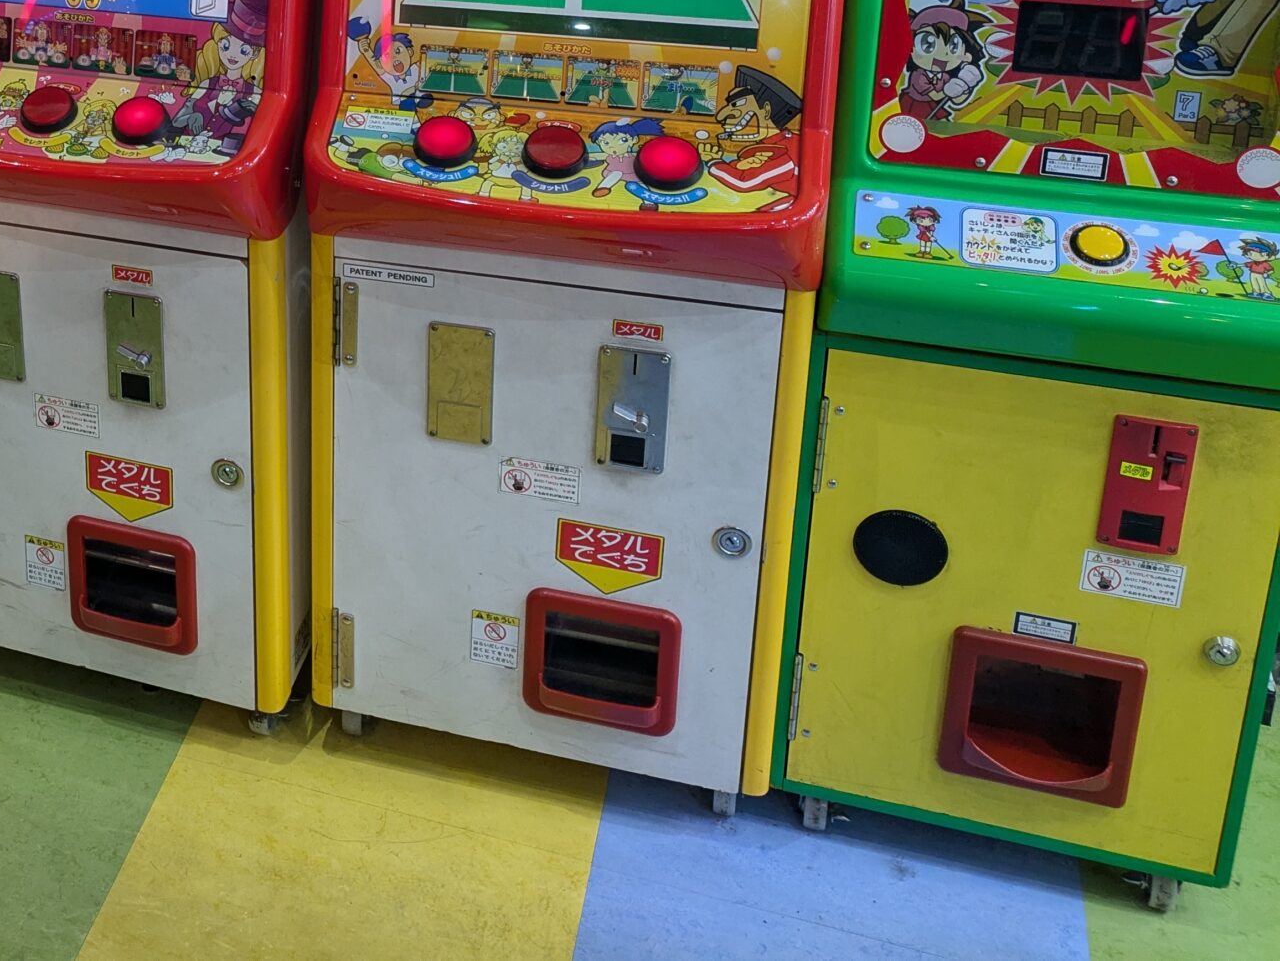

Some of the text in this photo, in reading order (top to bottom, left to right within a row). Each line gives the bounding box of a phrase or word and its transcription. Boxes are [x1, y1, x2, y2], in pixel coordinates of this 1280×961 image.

[54, 12, 95, 24] あそびかた
[543, 42, 592, 56] あそびかた
[1180, 93, 1194, 111] 7
[23, 138, 49, 146] セレクト
[115, 148, 141, 157] セレクト
[350, 267, 428, 284] PATENT PENDING
[98, 459, 161, 486] メダル
[98, 475, 162, 502] でぐち
[571, 526, 650, 555] メダル
[571, 545, 648, 573] でぐち
[1107, 556, 1135, 567] ちゅうい
[486, 614, 516, 624] ちゅうい
